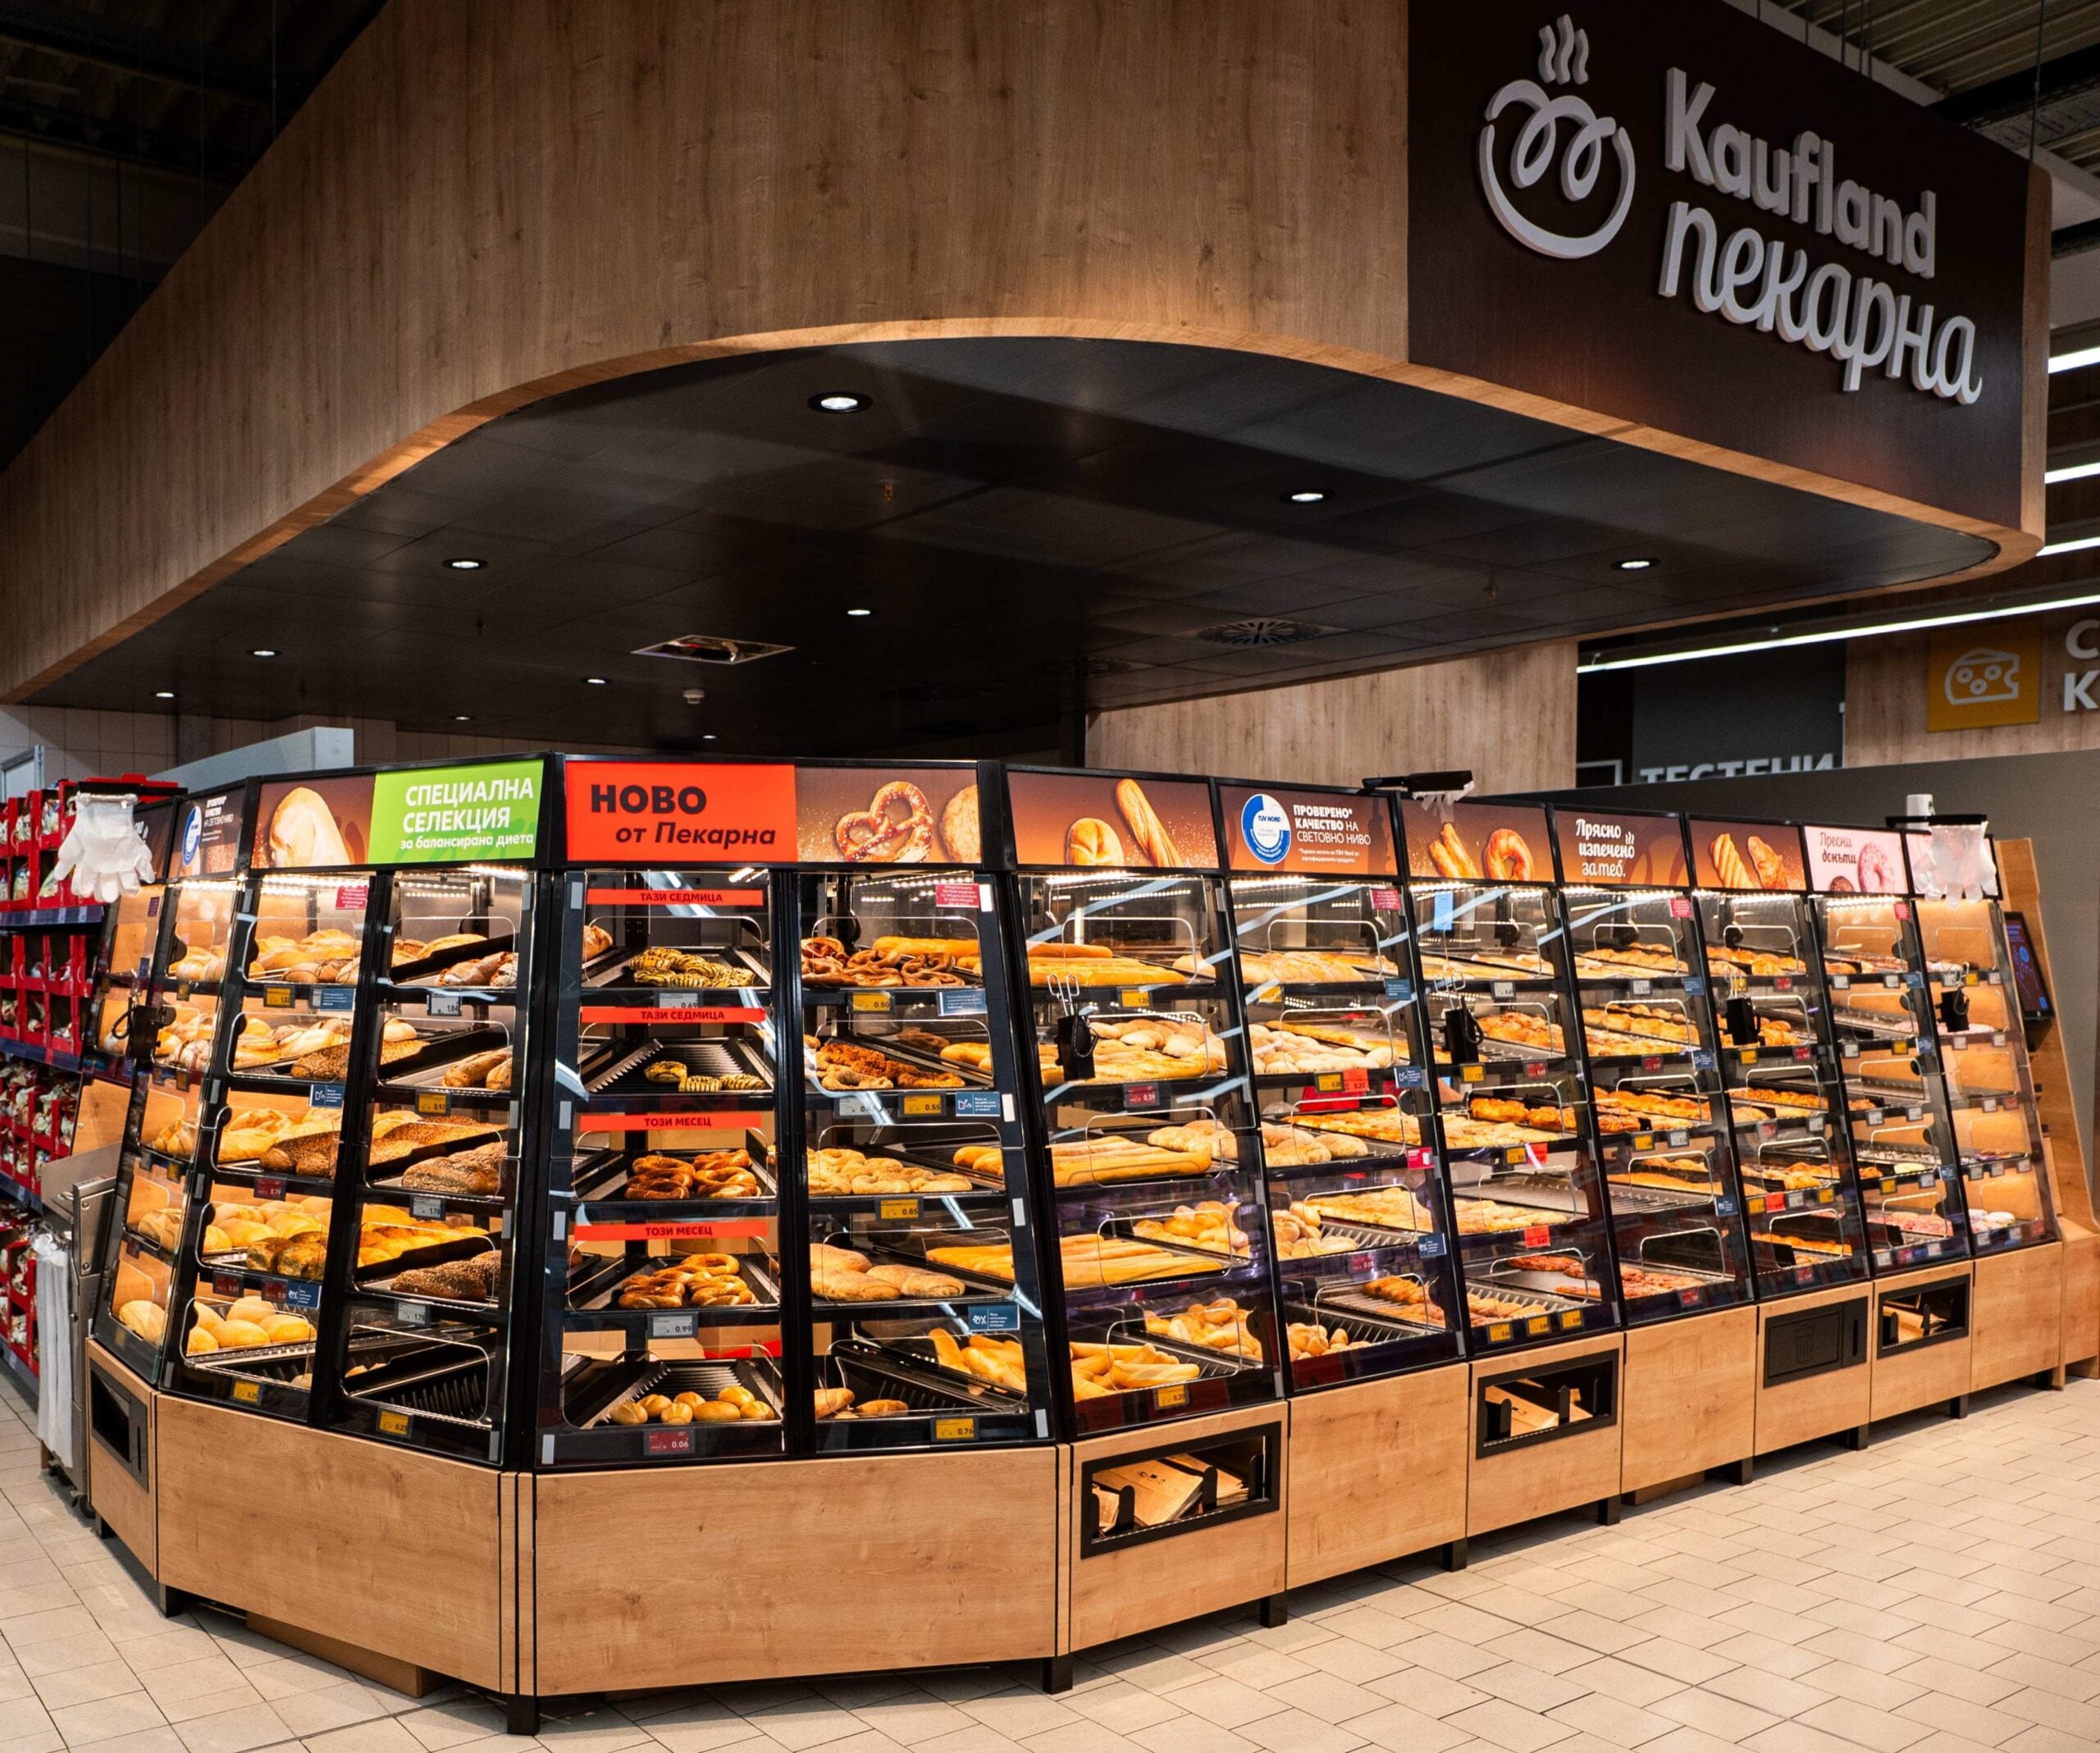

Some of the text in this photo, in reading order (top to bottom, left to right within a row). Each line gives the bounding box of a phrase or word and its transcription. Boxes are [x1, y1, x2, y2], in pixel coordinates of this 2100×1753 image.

[1664, 66, 1937, 279] Kaufland
[405, 777, 534, 807] СПЕЦИАЛНА
[591, 783, 707, 815] НОВО
[403, 806, 511, 833] СЕЛЕКЦИЯ
[1294, 818, 1359, 832] КАЧЕСТВО НА
[616, 821, 776, 850] от Пекарна
[1296, 830, 1372, 846] СВЕТОВНО НИВО
[1576, 819, 1621, 840] Прясно
[400, 833, 533, 850] за балансирана диета
[1820, 832, 1852, 848] Пресни
[1578, 842, 1635, 859] изпечено
[1582, 860, 1626, 877] за теб.
[640, 892, 723, 903] ТАЗИ СЕДМИЦА
[641, 1011, 724, 1020] ТАЗИ СЕДМИЦА
[644, 1116, 711, 1127] ТОЗИ МЕСЕЦ
[645, 1226, 713, 1237] ТОЗИ МЕСЕЦ
[671, 1440, 688, 1449] 0.06
